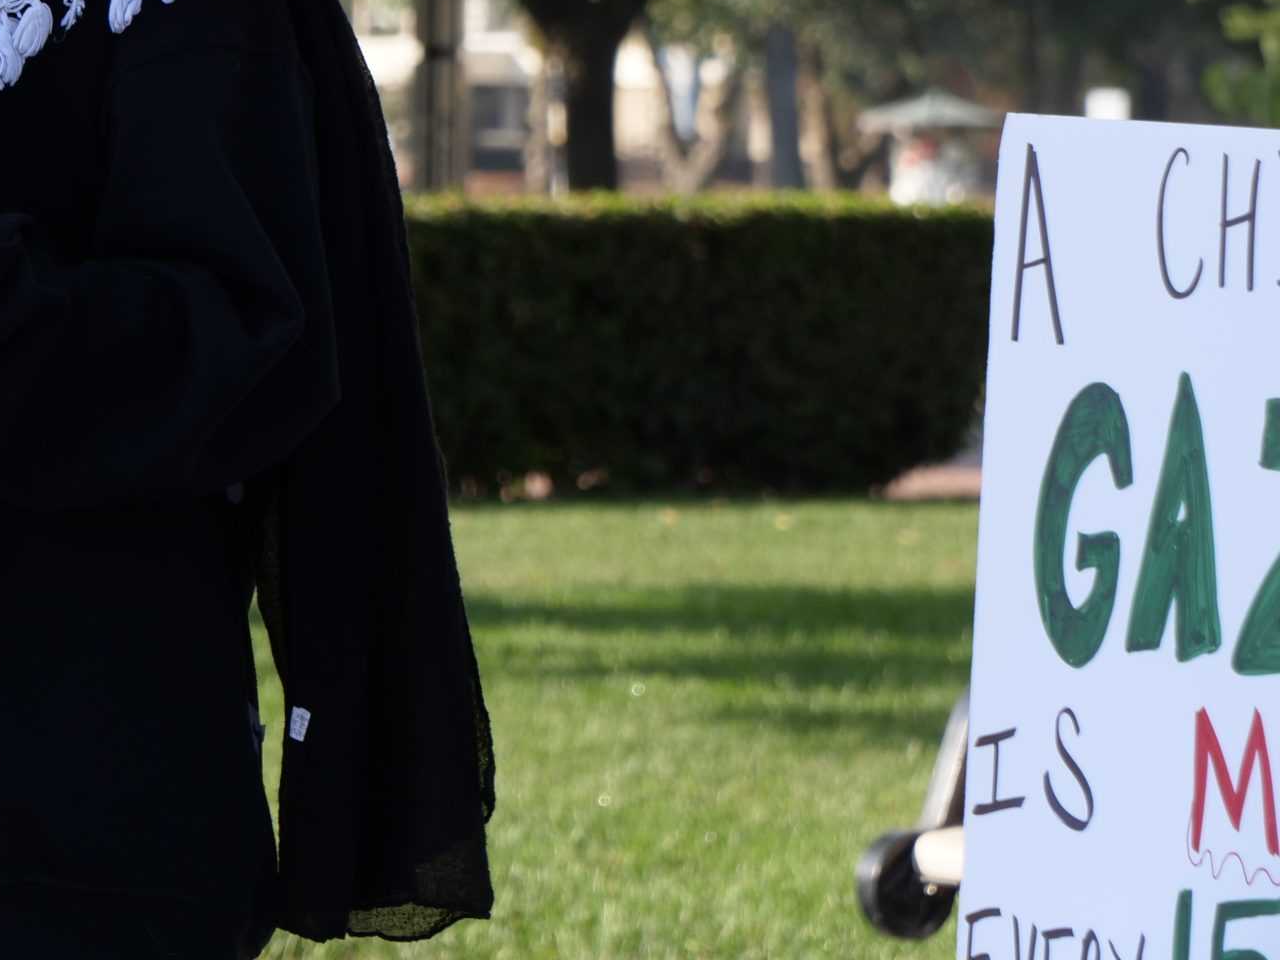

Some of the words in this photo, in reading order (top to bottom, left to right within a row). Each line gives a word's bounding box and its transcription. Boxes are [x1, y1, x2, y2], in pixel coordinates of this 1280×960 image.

[1011, 143, 1064, 344] A
[1157, 147, 1280, 299] CH
[972, 707, 1094, 832] IS
